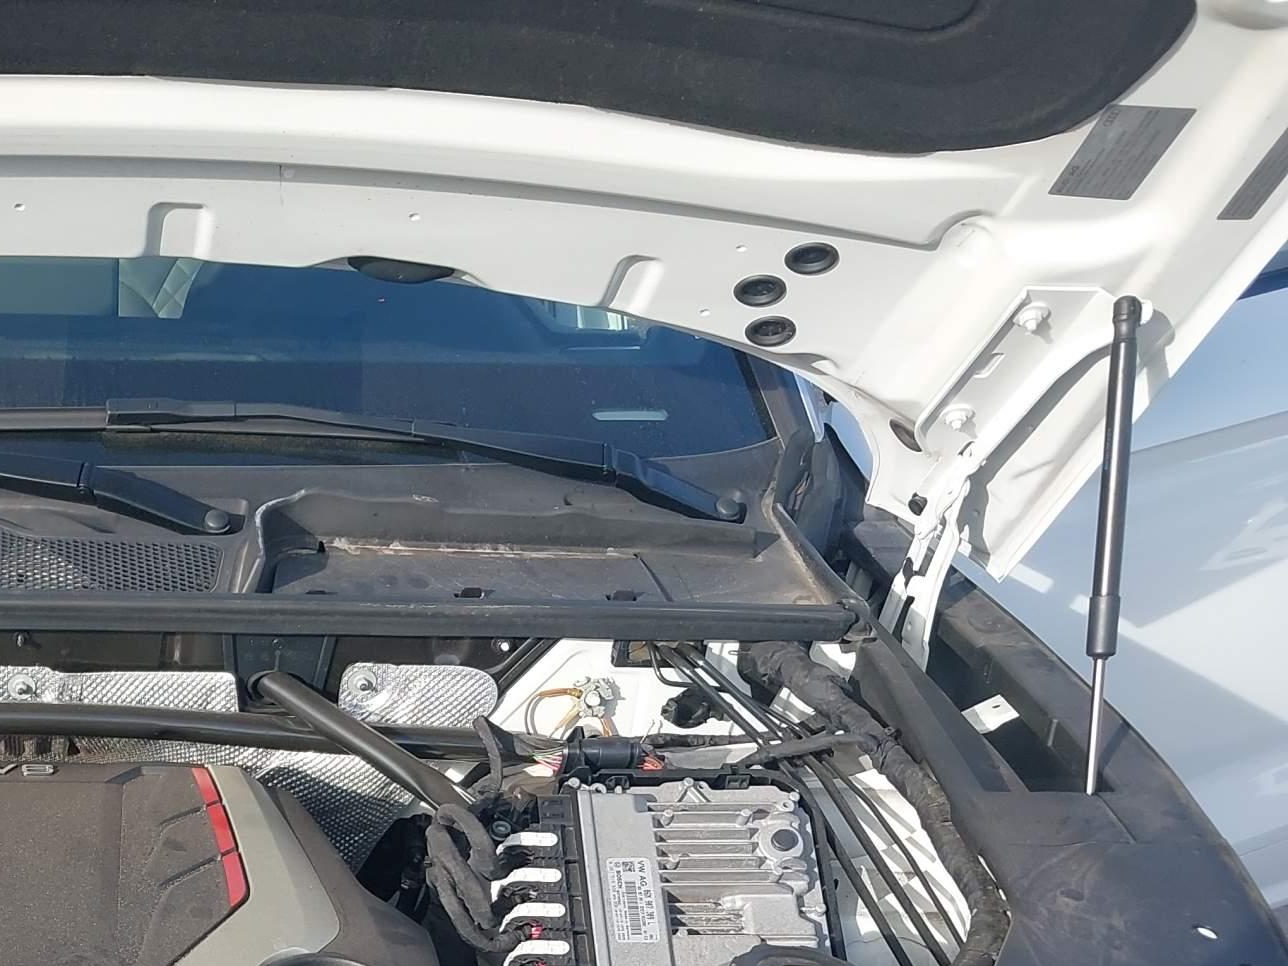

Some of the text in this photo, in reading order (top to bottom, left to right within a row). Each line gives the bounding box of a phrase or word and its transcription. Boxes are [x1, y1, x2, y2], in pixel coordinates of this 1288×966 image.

[637, 860, 646, 873] VW
[615, 870, 623, 889] BOSCH
[639, 875, 648, 887] AG
